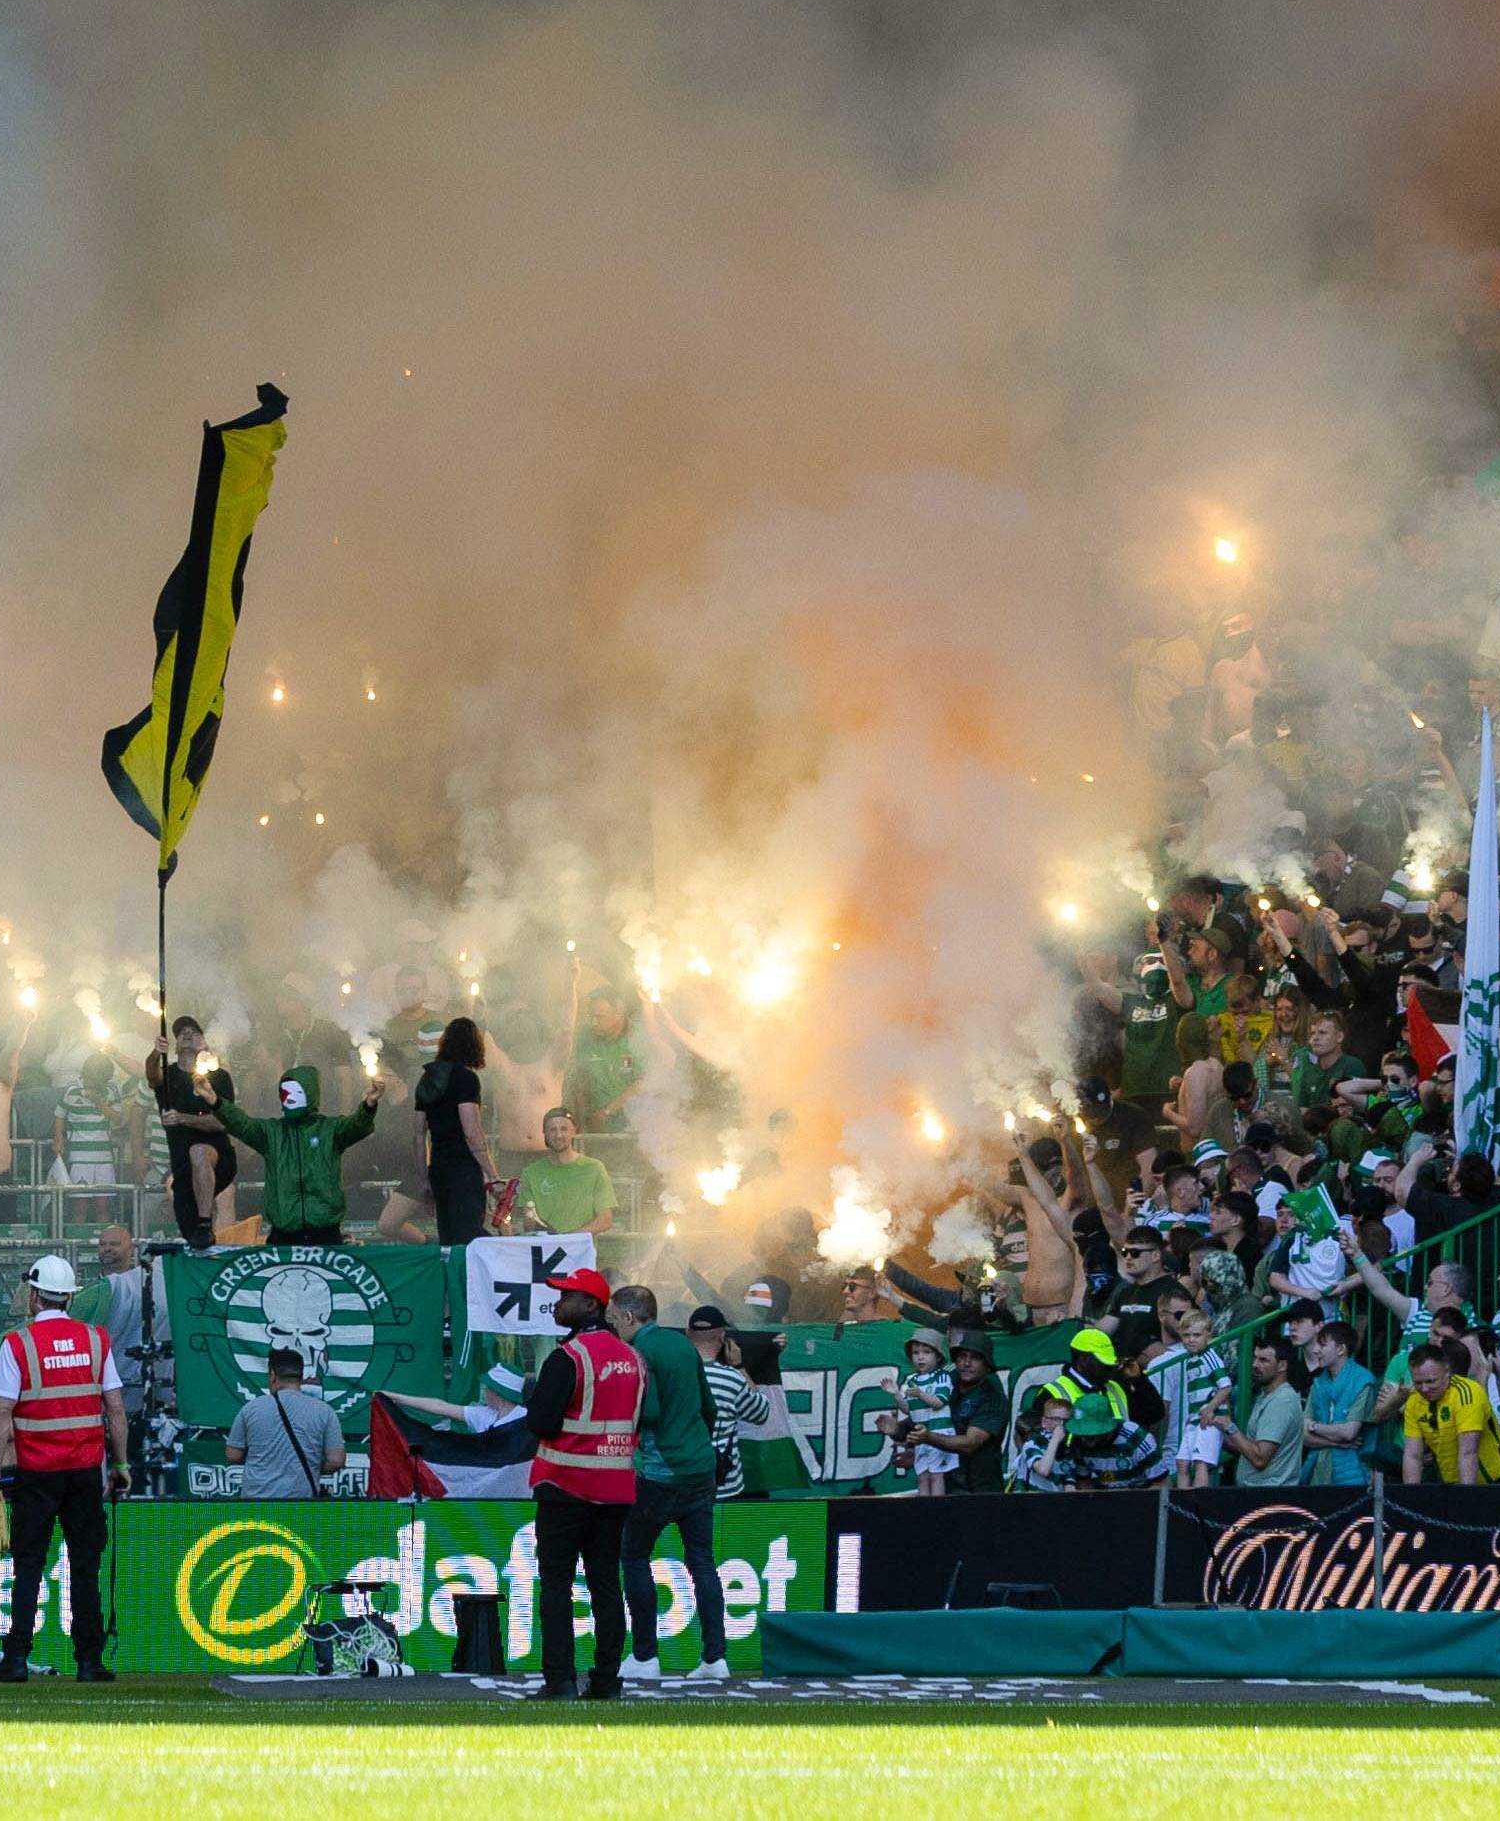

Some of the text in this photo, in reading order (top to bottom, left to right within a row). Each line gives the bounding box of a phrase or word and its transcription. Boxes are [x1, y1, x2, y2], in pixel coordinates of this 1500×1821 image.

[211, 1245, 389, 1309] GREEN BRIGADE
[539, 1302, 556, 1315] et
[53, 1339, 75, 1353] FIRE
[43, 1353, 91, 1370] STEWARD
